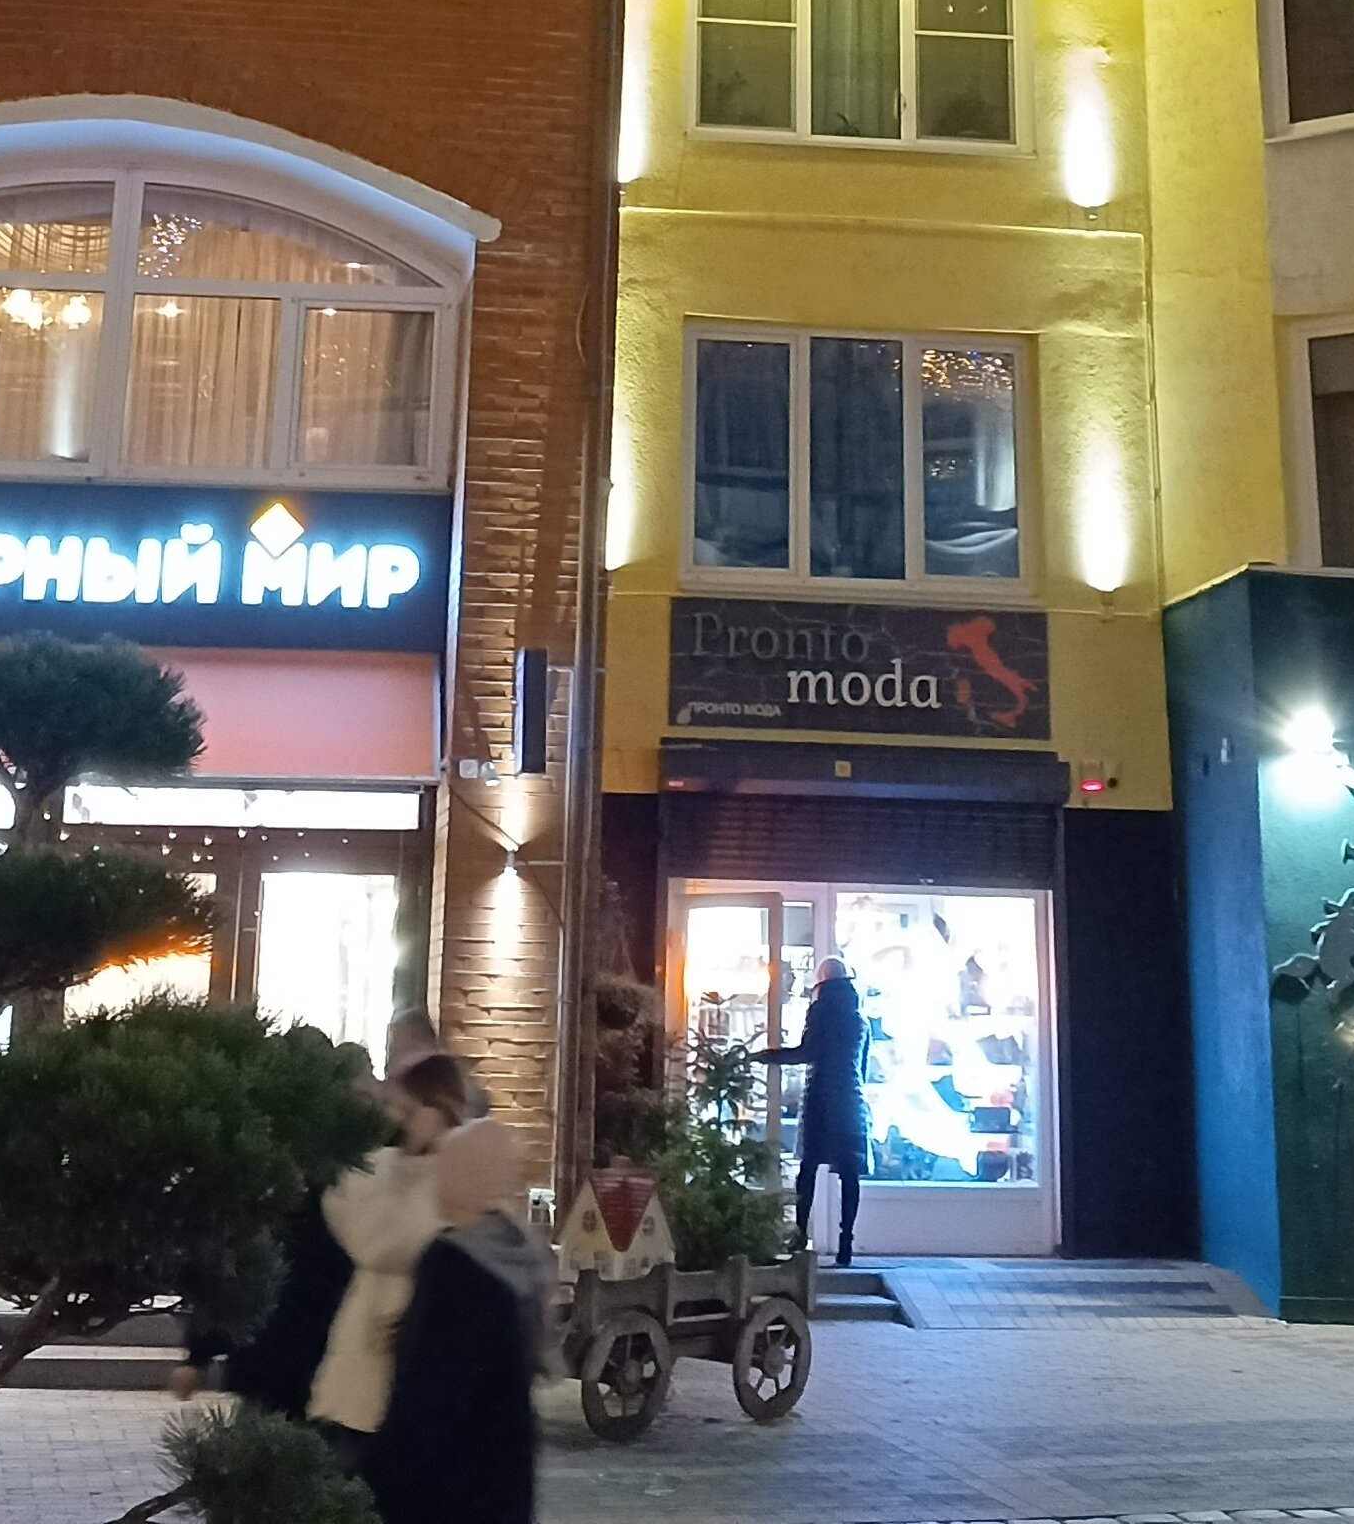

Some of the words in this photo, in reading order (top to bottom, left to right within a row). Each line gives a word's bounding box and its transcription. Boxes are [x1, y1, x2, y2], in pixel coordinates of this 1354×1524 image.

[240, 542, 420, 609] МИР
[691, 611, 873, 663] Pronto
[786, 658, 943, 710] moda
